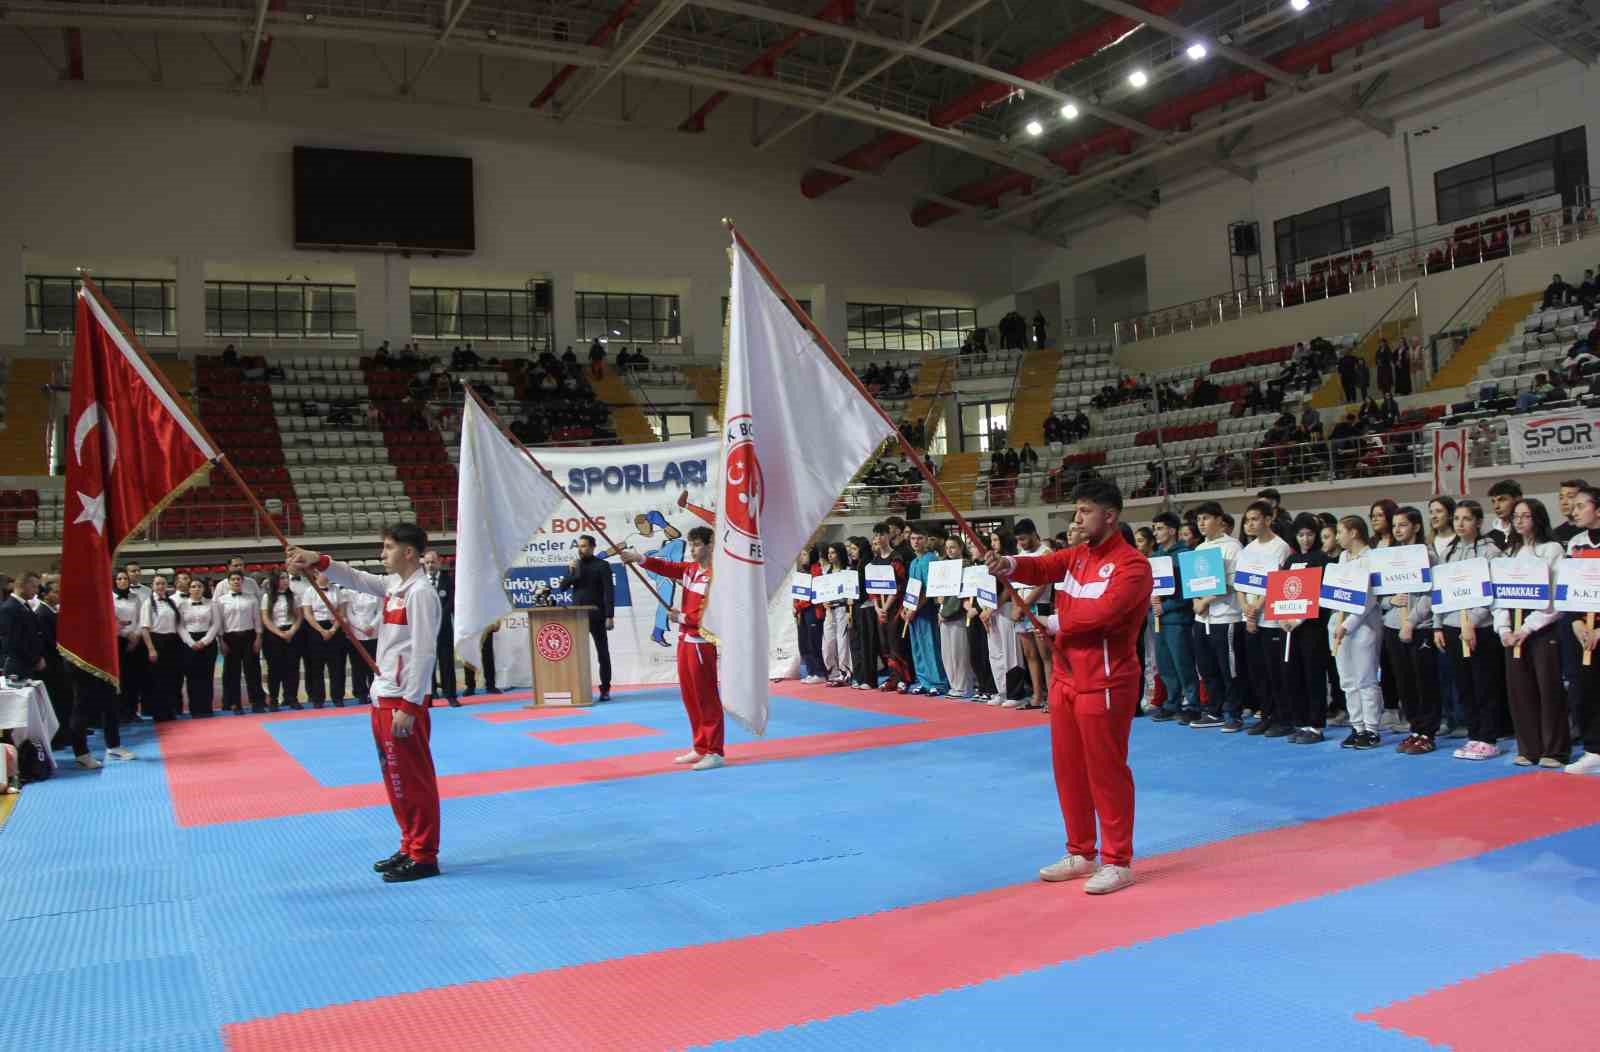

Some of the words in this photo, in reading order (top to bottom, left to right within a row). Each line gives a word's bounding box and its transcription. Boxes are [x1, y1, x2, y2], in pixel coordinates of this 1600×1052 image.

[1524, 423, 1592, 448] SPOR
[568, 459, 707, 494] SPORLARI
[552, 516, 607, 534] BOKS
[520, 539, 565, 554] ençler
[503, 577, 546, 592] ürkiye
[1496, 586, 1540, 598] ÇANAKKALE
